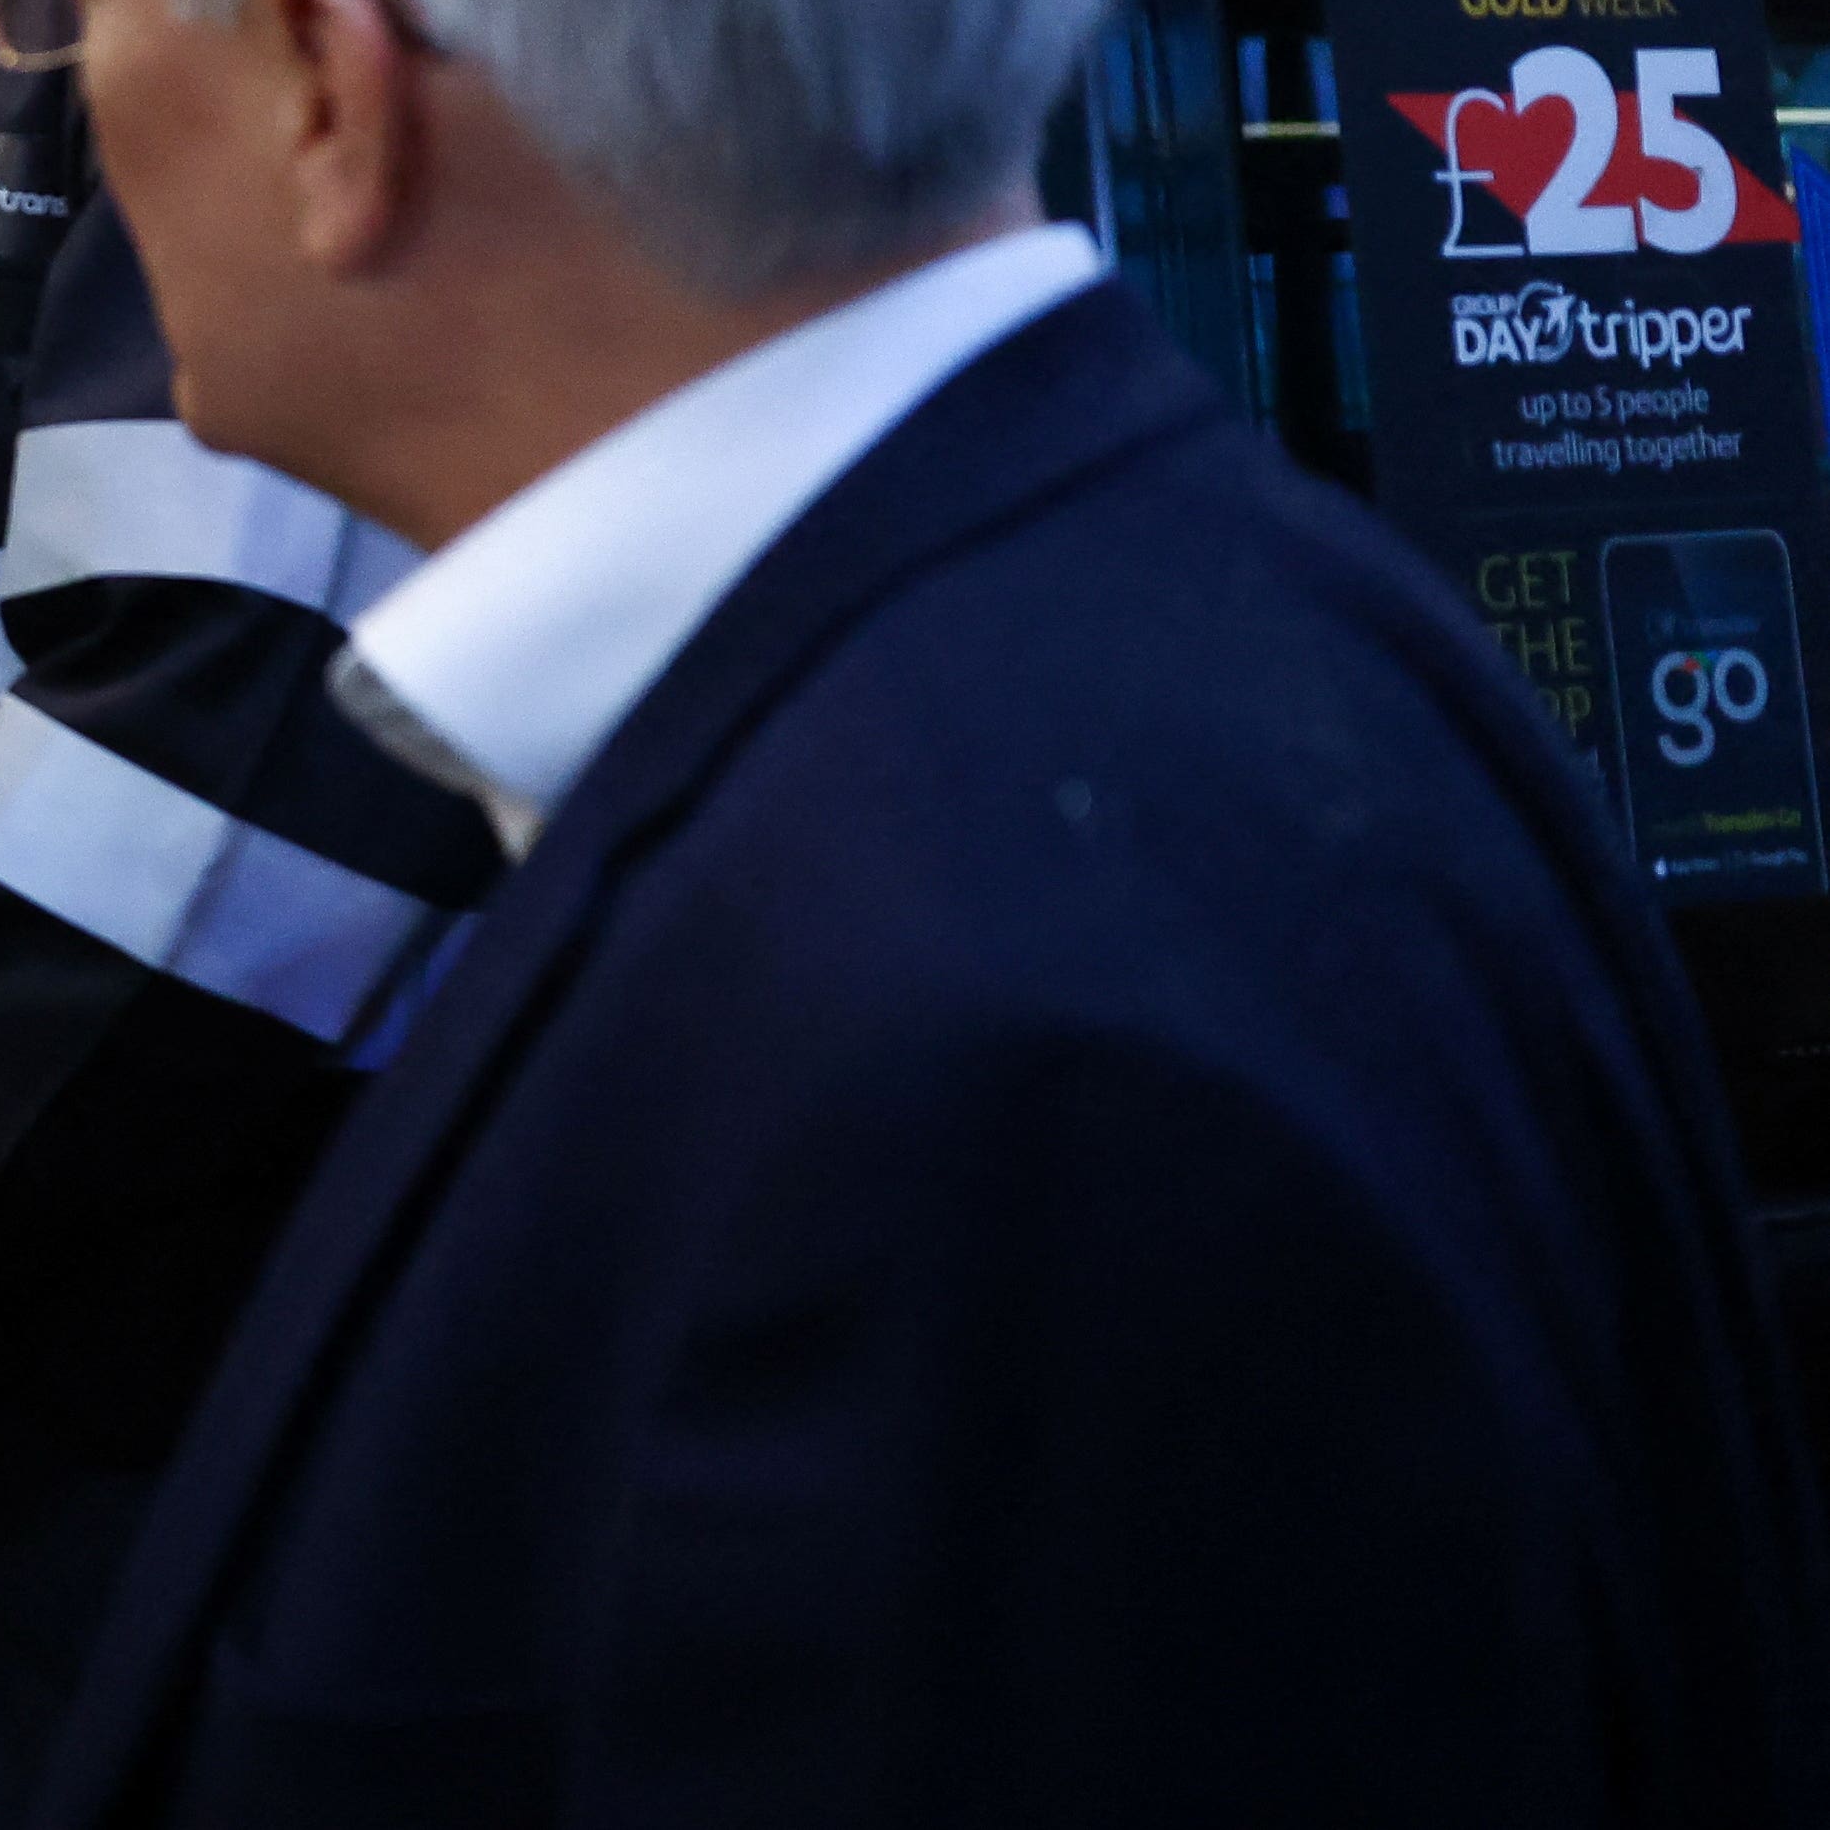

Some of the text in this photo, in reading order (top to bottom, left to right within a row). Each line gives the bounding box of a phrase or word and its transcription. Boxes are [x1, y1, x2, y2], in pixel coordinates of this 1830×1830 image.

[1433, 44, 1738, 257] £25
[1453, 297, 1753, 370] DAY tripper
[1519, 377, 1711, 426] up to 5 people
[1491, 424, 1742, 474] travelling together
[1476, 550, 1578, 613] GET
[1650, 645, 1770, 767] go
